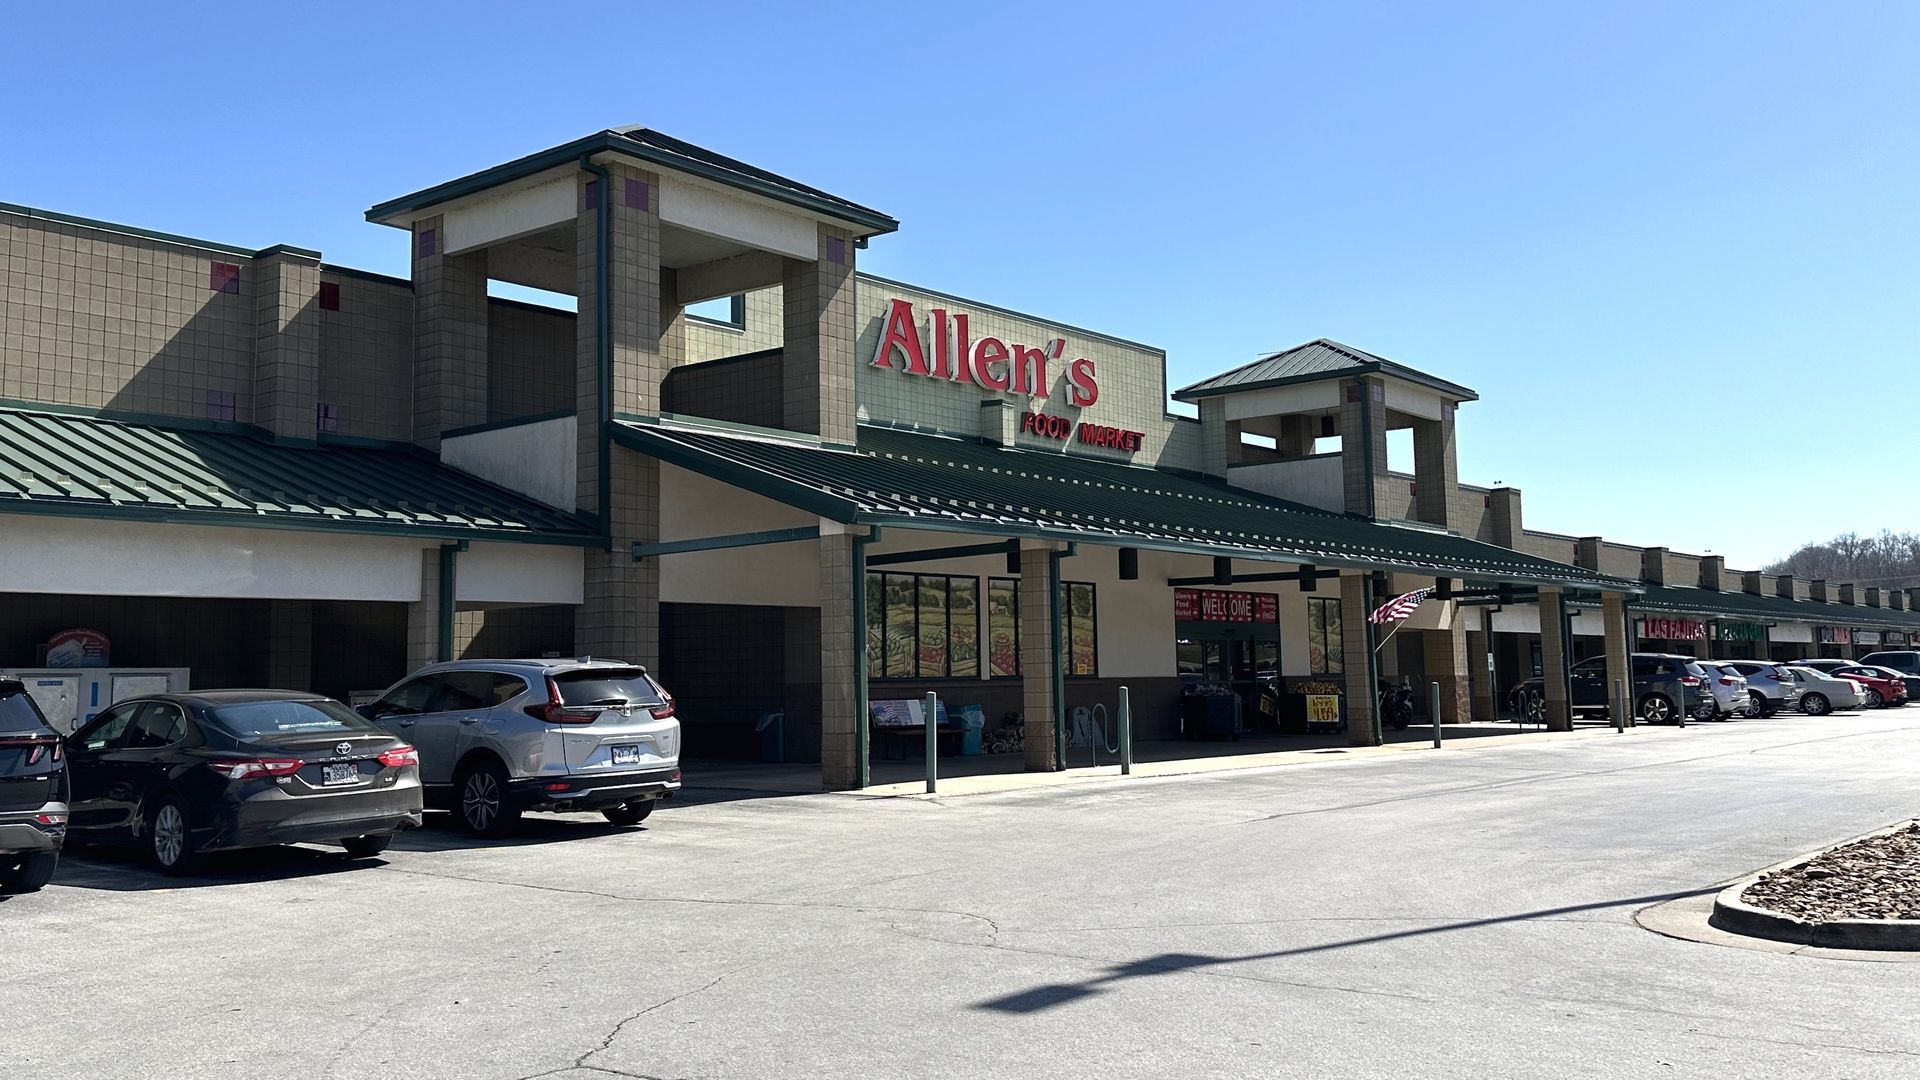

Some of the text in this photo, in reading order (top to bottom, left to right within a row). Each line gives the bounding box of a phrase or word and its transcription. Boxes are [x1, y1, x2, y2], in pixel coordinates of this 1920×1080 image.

[869, 298, 1098, 408] Allen's
[1020, 411, 1145, 452] FOOD MARKET
[1648, 620, 1706, 640] LAS FAJITAS
